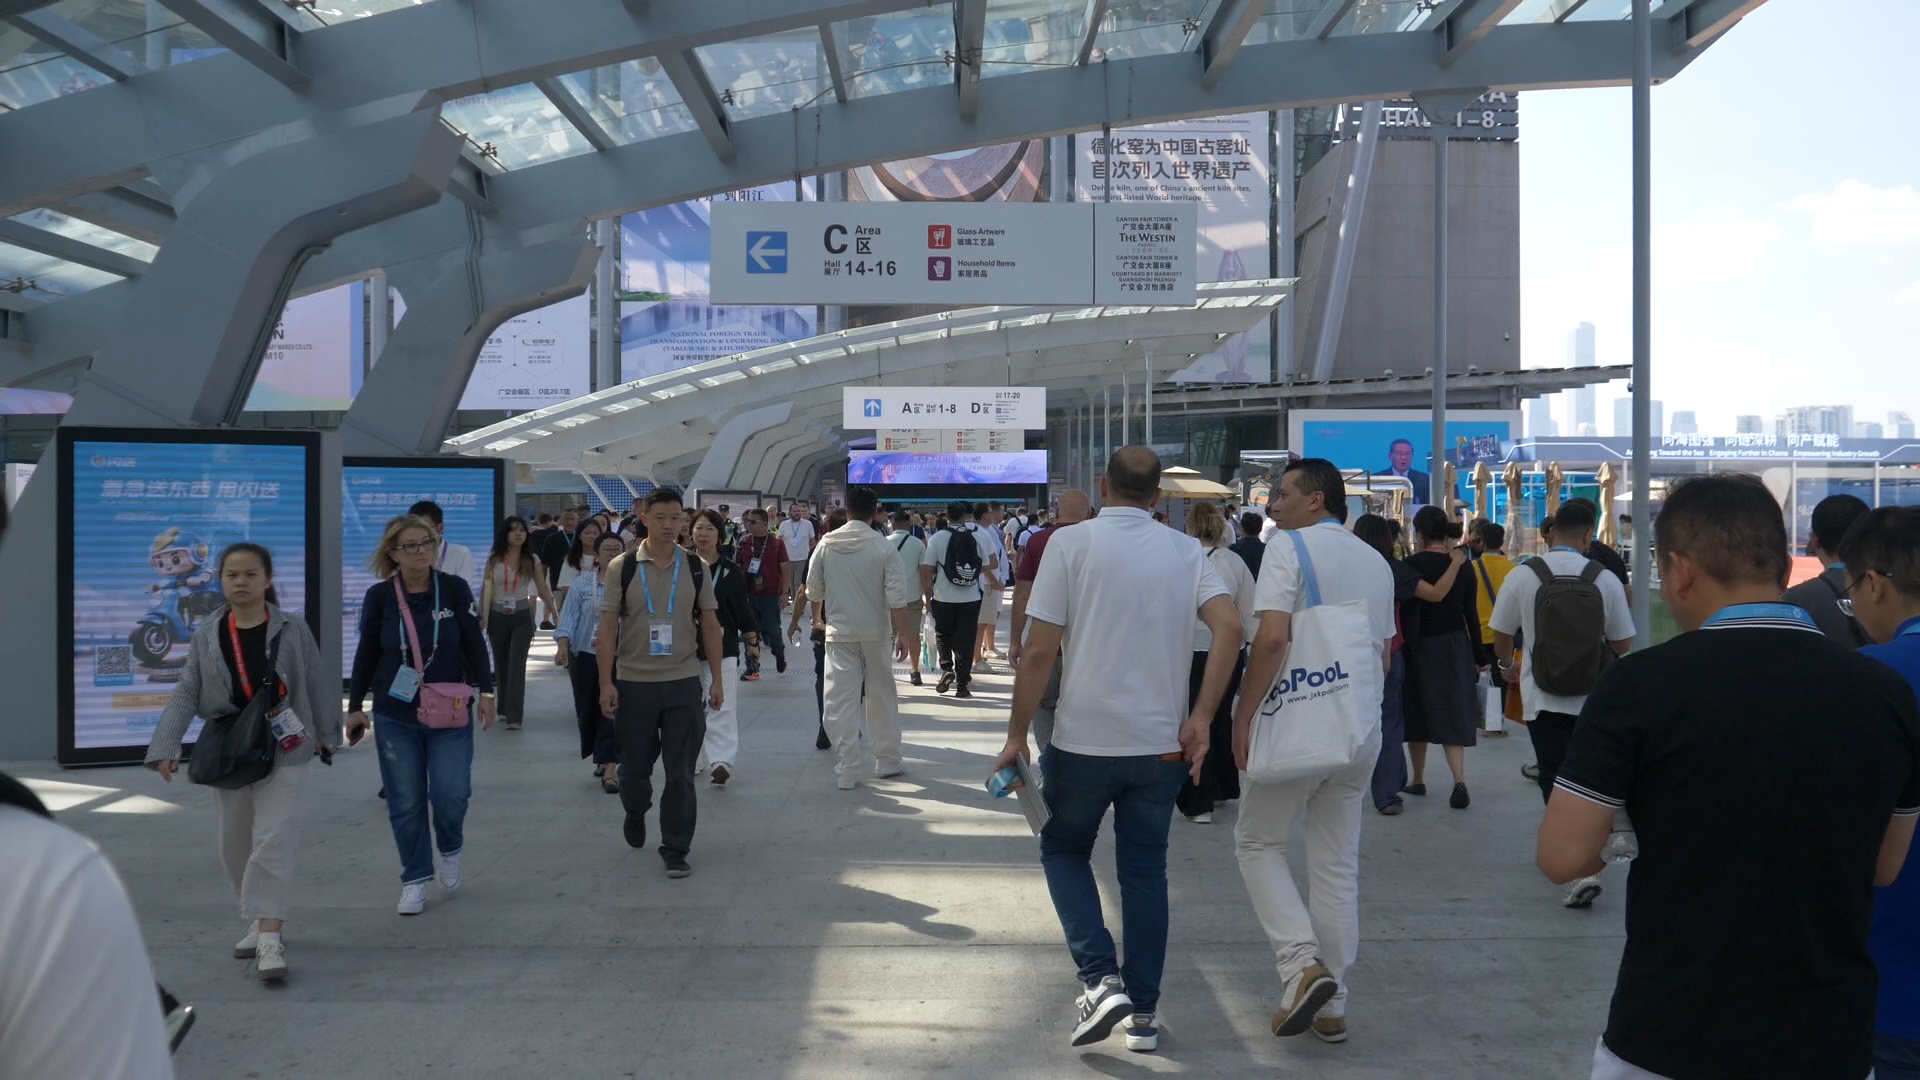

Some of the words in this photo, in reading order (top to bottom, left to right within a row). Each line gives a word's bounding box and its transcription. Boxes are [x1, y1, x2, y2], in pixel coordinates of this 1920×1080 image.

[1385, 110, 1433, 127] HAL
[1456, 110, 1496, 129] 1-8
[1091, 138, 1251, 156] 德化窑为中国古窑址
[1091, 161, 1251, 180] 首次列入世界遗产
[1091, 184, 1115, 192] Deha
[1117, 184, 1133, 193] kiln,
[1150, 184, 1159, 192] of
[1160, 184, 1187, 192] China's
[1188, 184, 1216, 192] ancient
[1217, 184, 1231, 192] kiln
[1109, 193, 1122, 201] irst
[1124, 193, 1144, 201] listed
[1145, 193, 1169, 201] World
[1122, 223, 1172, 231] 广交会大厦A座
[823, 224, 848, 254] C
[855, 225, 881, 235] Area
[957, 238, 995, 246] 玻璃工艺品
[1119, 233, 1138, 242] THE
[1138, 233, 1176, 242] WESTIN
[856, 237, 872, 255] 区
[957, 259, 996, 267] Household
[1122, 262, 1172, 270] 广交会大厦B座
[824, 260, 841, 268] Hall
[845, 260, 897, 276] 14-16
[824, 268, 841, 276] 展厅
[957, 269, 988, 278] 家居用品
[902, 403, 912, 414] A
[938, 404, 957, 414] 1-8
[971, 403, 981, 414] D
[1709, 449, 1738, 458] Engaging
[101, 479, 212, 499] 着急送东西
[215, 480, 281, 499] 用闪送
